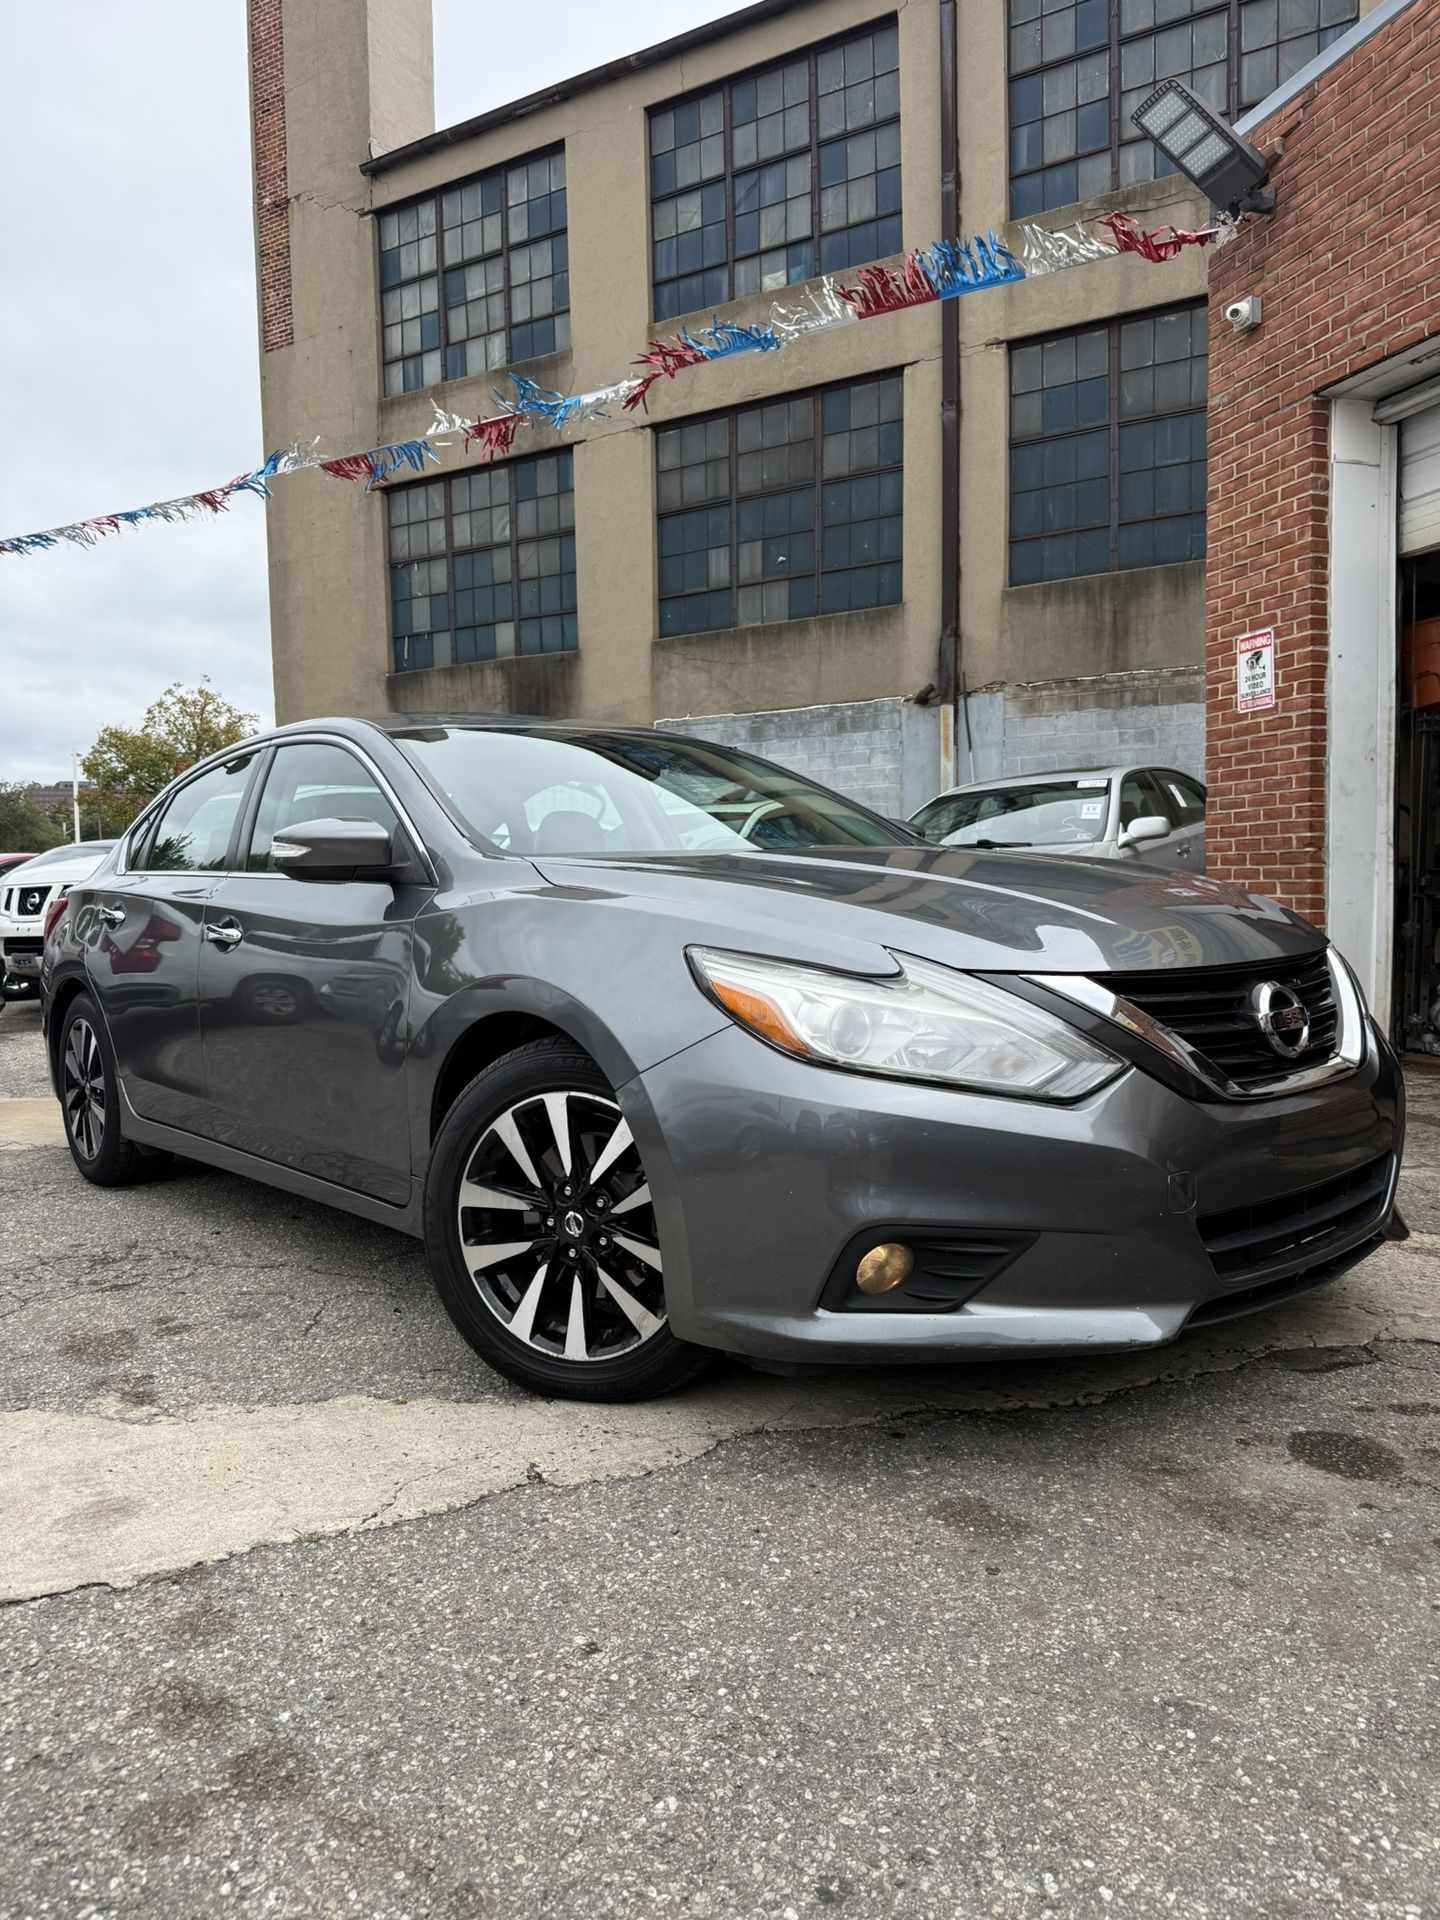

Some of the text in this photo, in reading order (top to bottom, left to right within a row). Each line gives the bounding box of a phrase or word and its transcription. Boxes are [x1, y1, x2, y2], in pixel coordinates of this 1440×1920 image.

[1240, 635, 1271, 651] WARNING
[1244, 672, 1266, 683] 24 HOUR
[1248, 681, 1263, 690] VIDEO
